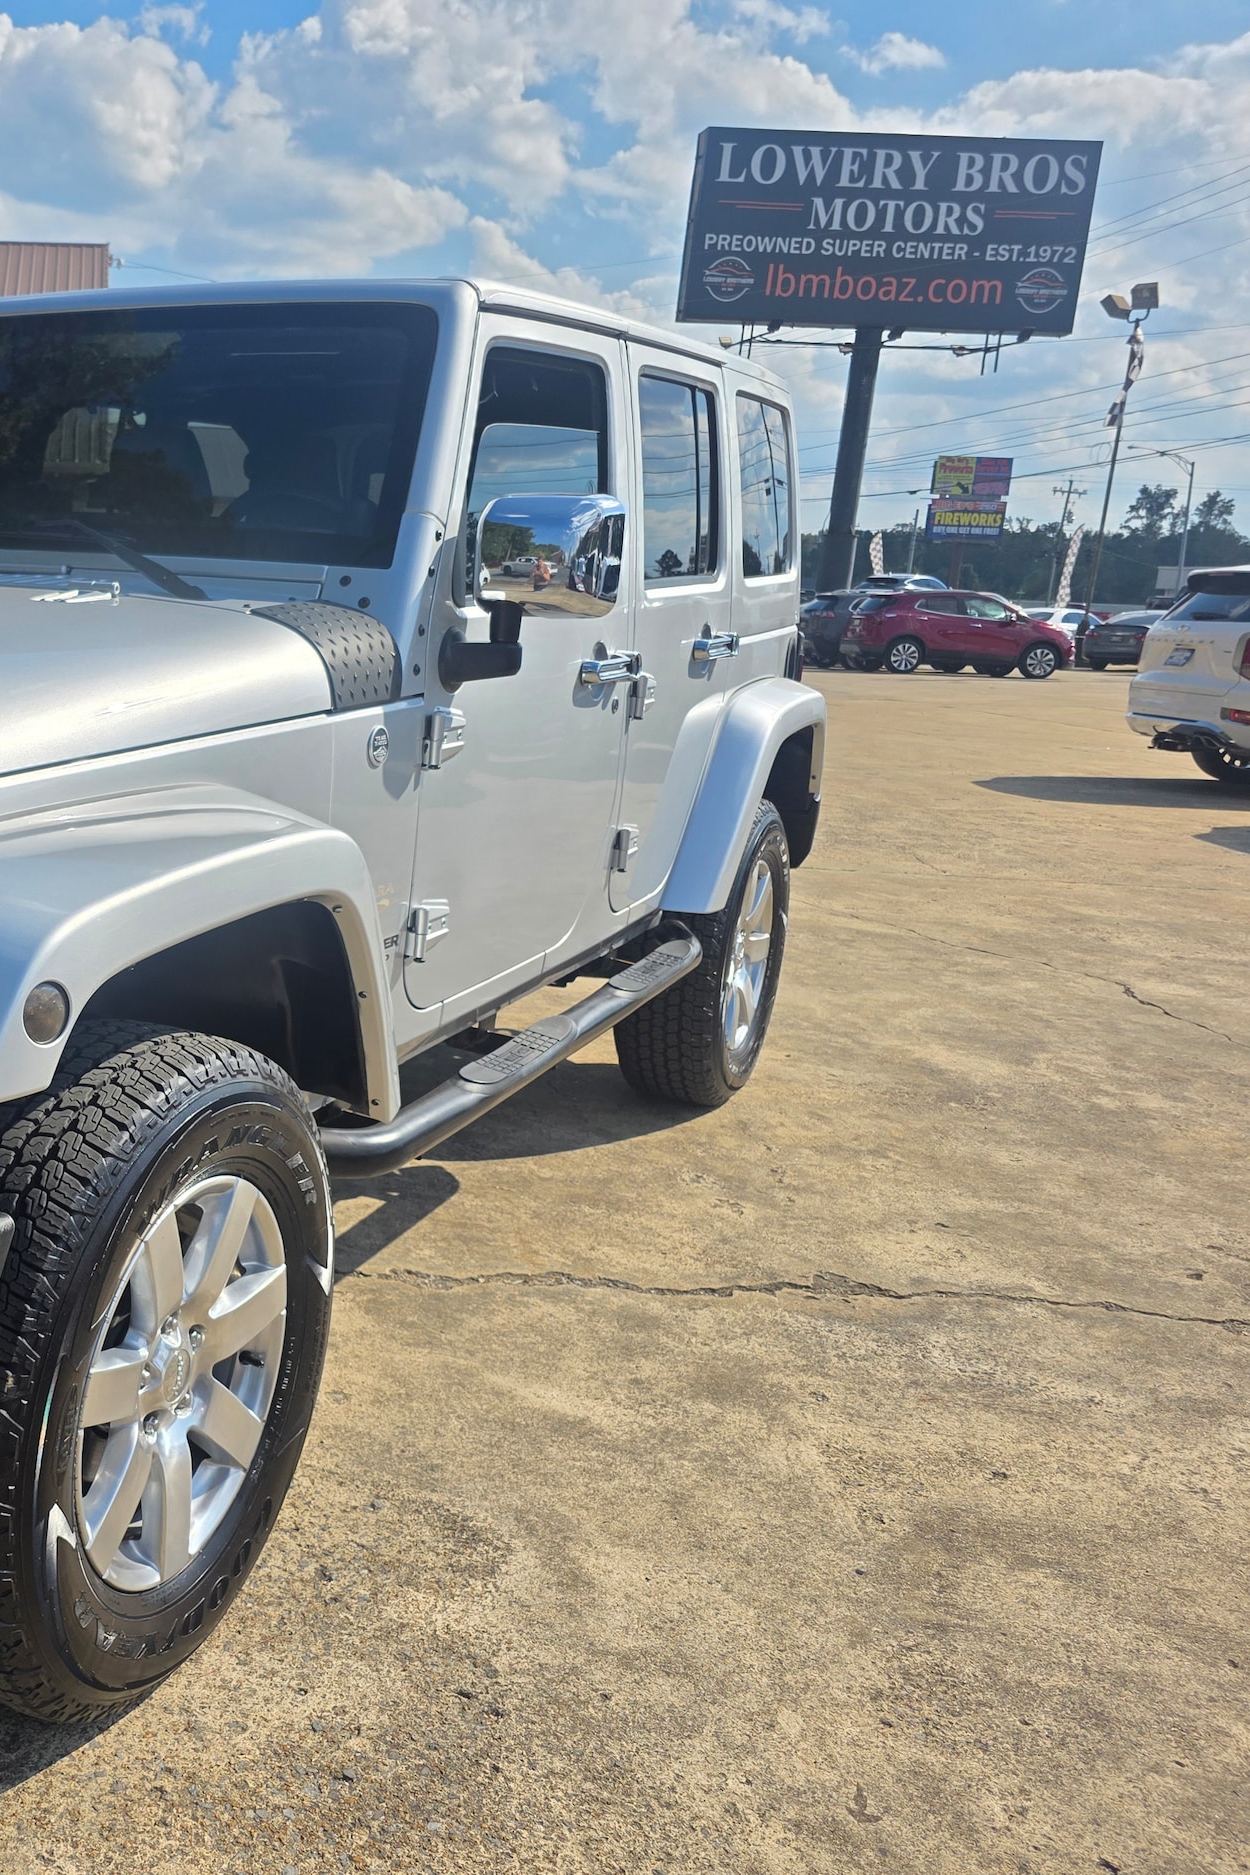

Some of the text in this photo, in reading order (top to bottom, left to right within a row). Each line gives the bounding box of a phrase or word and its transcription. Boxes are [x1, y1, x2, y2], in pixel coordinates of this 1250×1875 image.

[715, 142, 1088, 196] LOWERY BROS
[806, 197, 986, 237] MOTORS
[704, 234, 816, 256] PREOWNED
[820, 239, 887, 259] SUPER
[892, 241, 967, 261] CENTER
[985, 244, 1077, 264] EST.1972
[764, 264, 1003, 305] lbmboaz.com
[934, 511, 1003, 527] FIREWORKS
[73, 1495, 273, 1660] GOODYEAR
